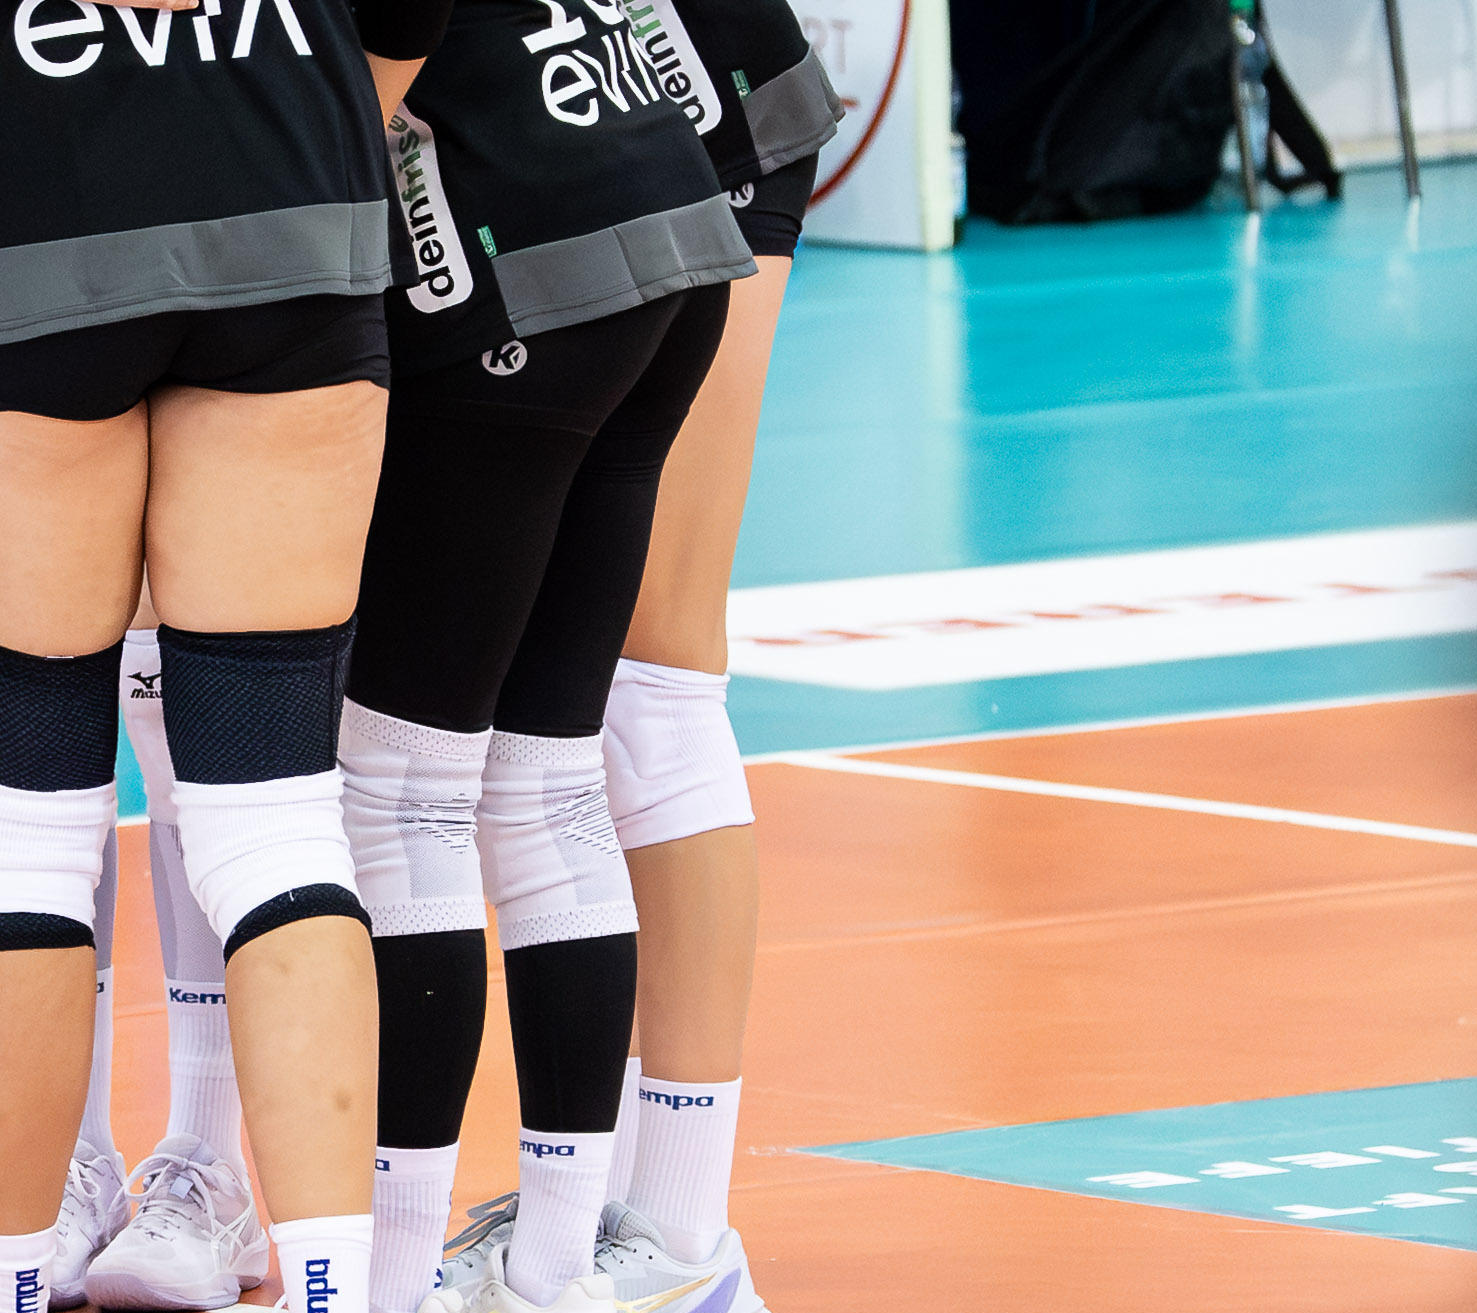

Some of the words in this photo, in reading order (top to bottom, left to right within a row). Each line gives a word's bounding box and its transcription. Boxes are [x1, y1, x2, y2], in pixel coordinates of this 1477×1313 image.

[169, 987, 226, 1005] Kem
[639, 1087, 715, 1111] empa
[519, 1138, 576, 1158] mpa
